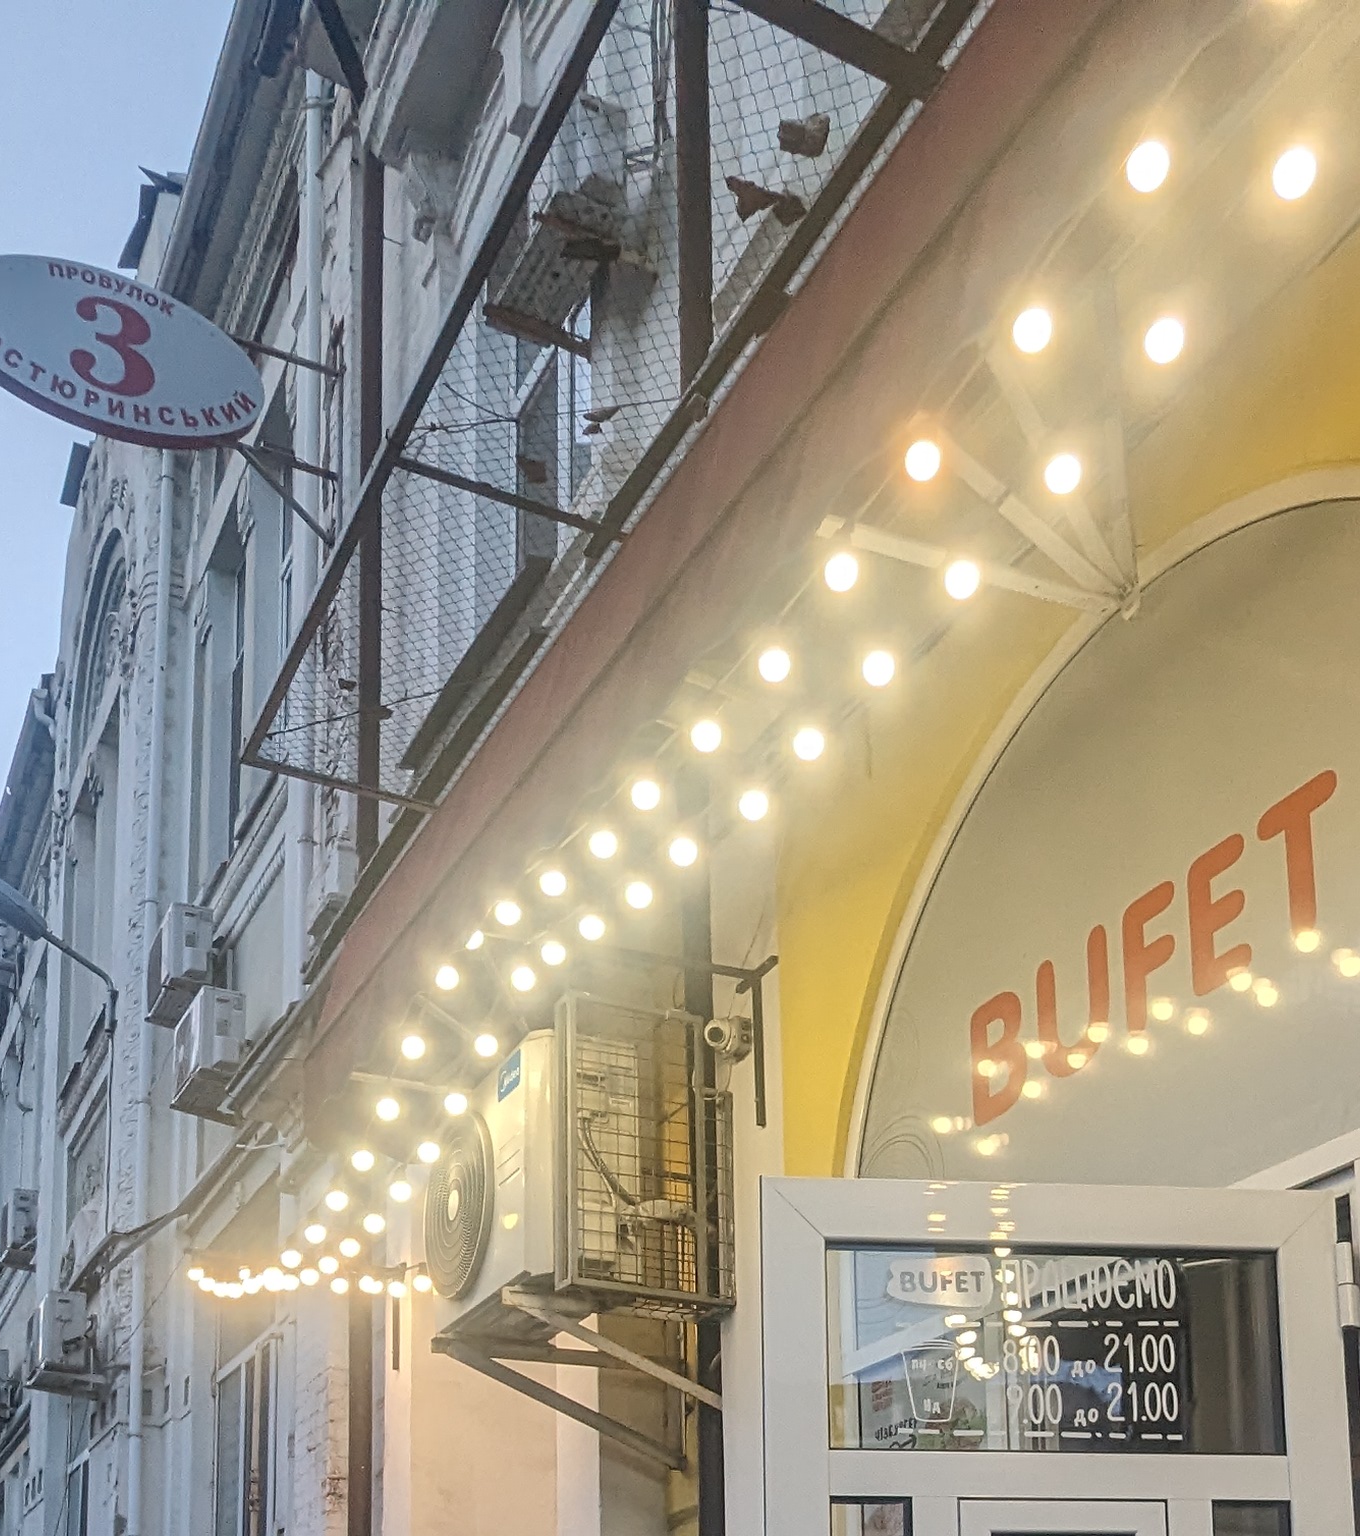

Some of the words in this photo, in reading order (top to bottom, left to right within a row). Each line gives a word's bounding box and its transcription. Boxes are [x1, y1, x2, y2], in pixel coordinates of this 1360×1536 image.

[48, 262, 175, 317] ПРОВУЛОК
[70, 296, 155, 397] 3
[970, 769, 1338, 1127] BUFET
[899, 1270, 986, 1293] BUFET
[1071, 1360, 1096, 1378] до
[1104, 1332, 1176, 1374] 21.00
[1006, 1383, 1063, 1425] 9.00
[1074, 1408, 1099, 1427] до
[1106, 1381, 1179, 1423] 21.00
